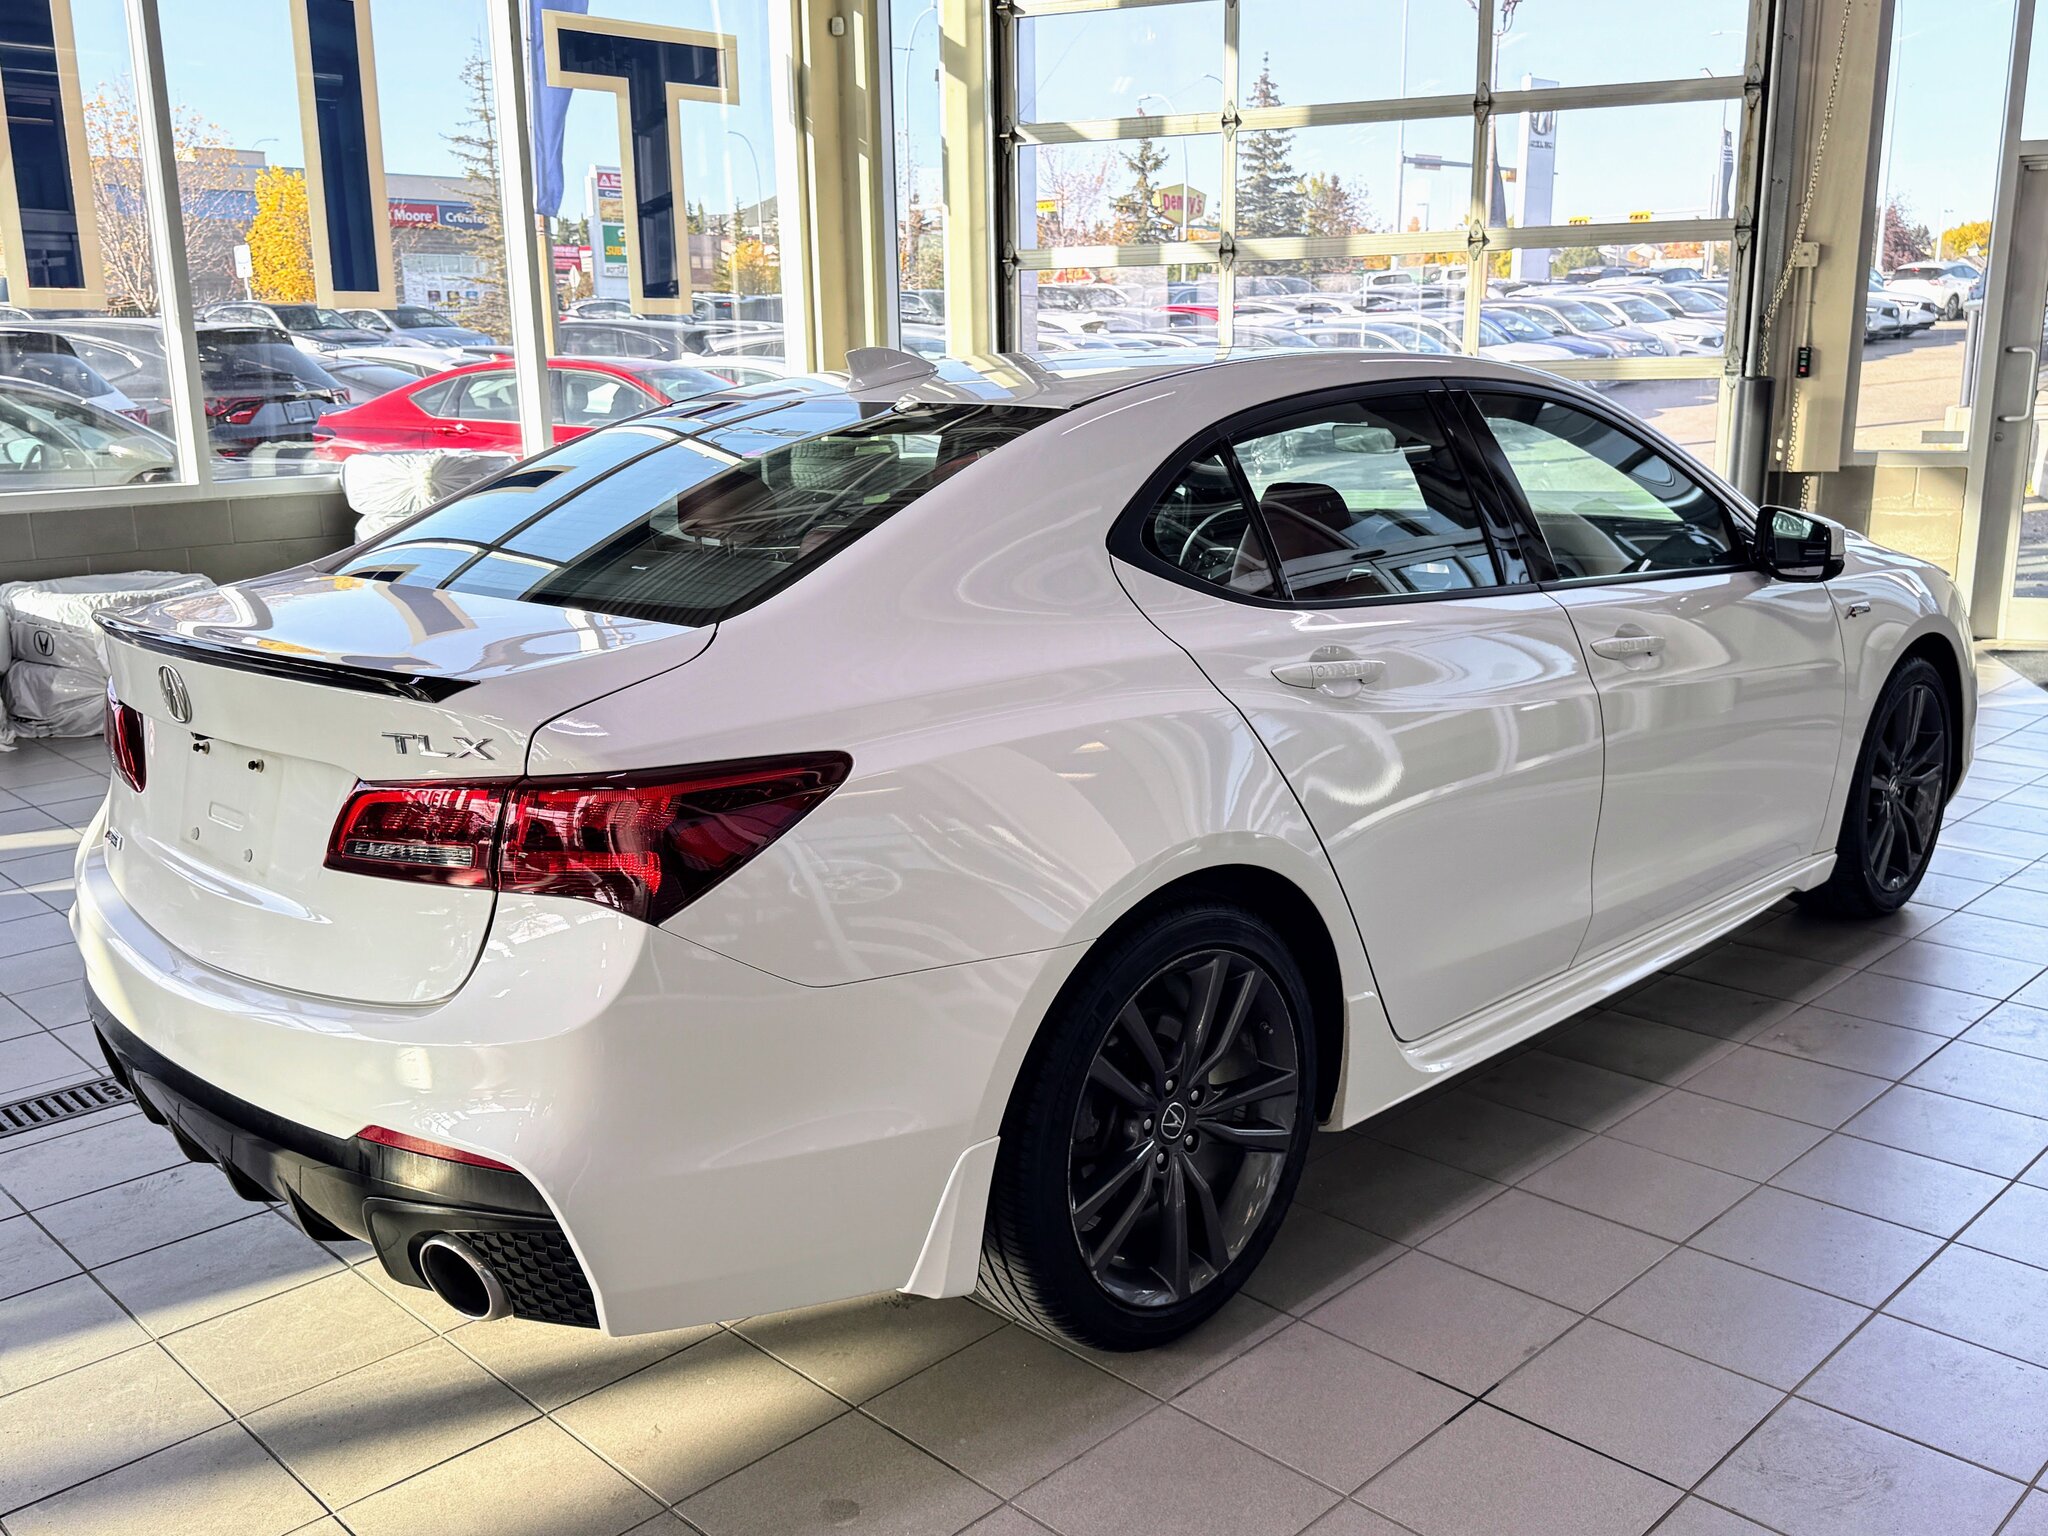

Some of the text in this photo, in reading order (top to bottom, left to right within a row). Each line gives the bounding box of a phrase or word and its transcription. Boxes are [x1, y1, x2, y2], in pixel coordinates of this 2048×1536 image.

[1163, 194, 1203, 214] Deny's
[393, 208, 433, 223] Moore
[382, 732, 496, 761] TLX
